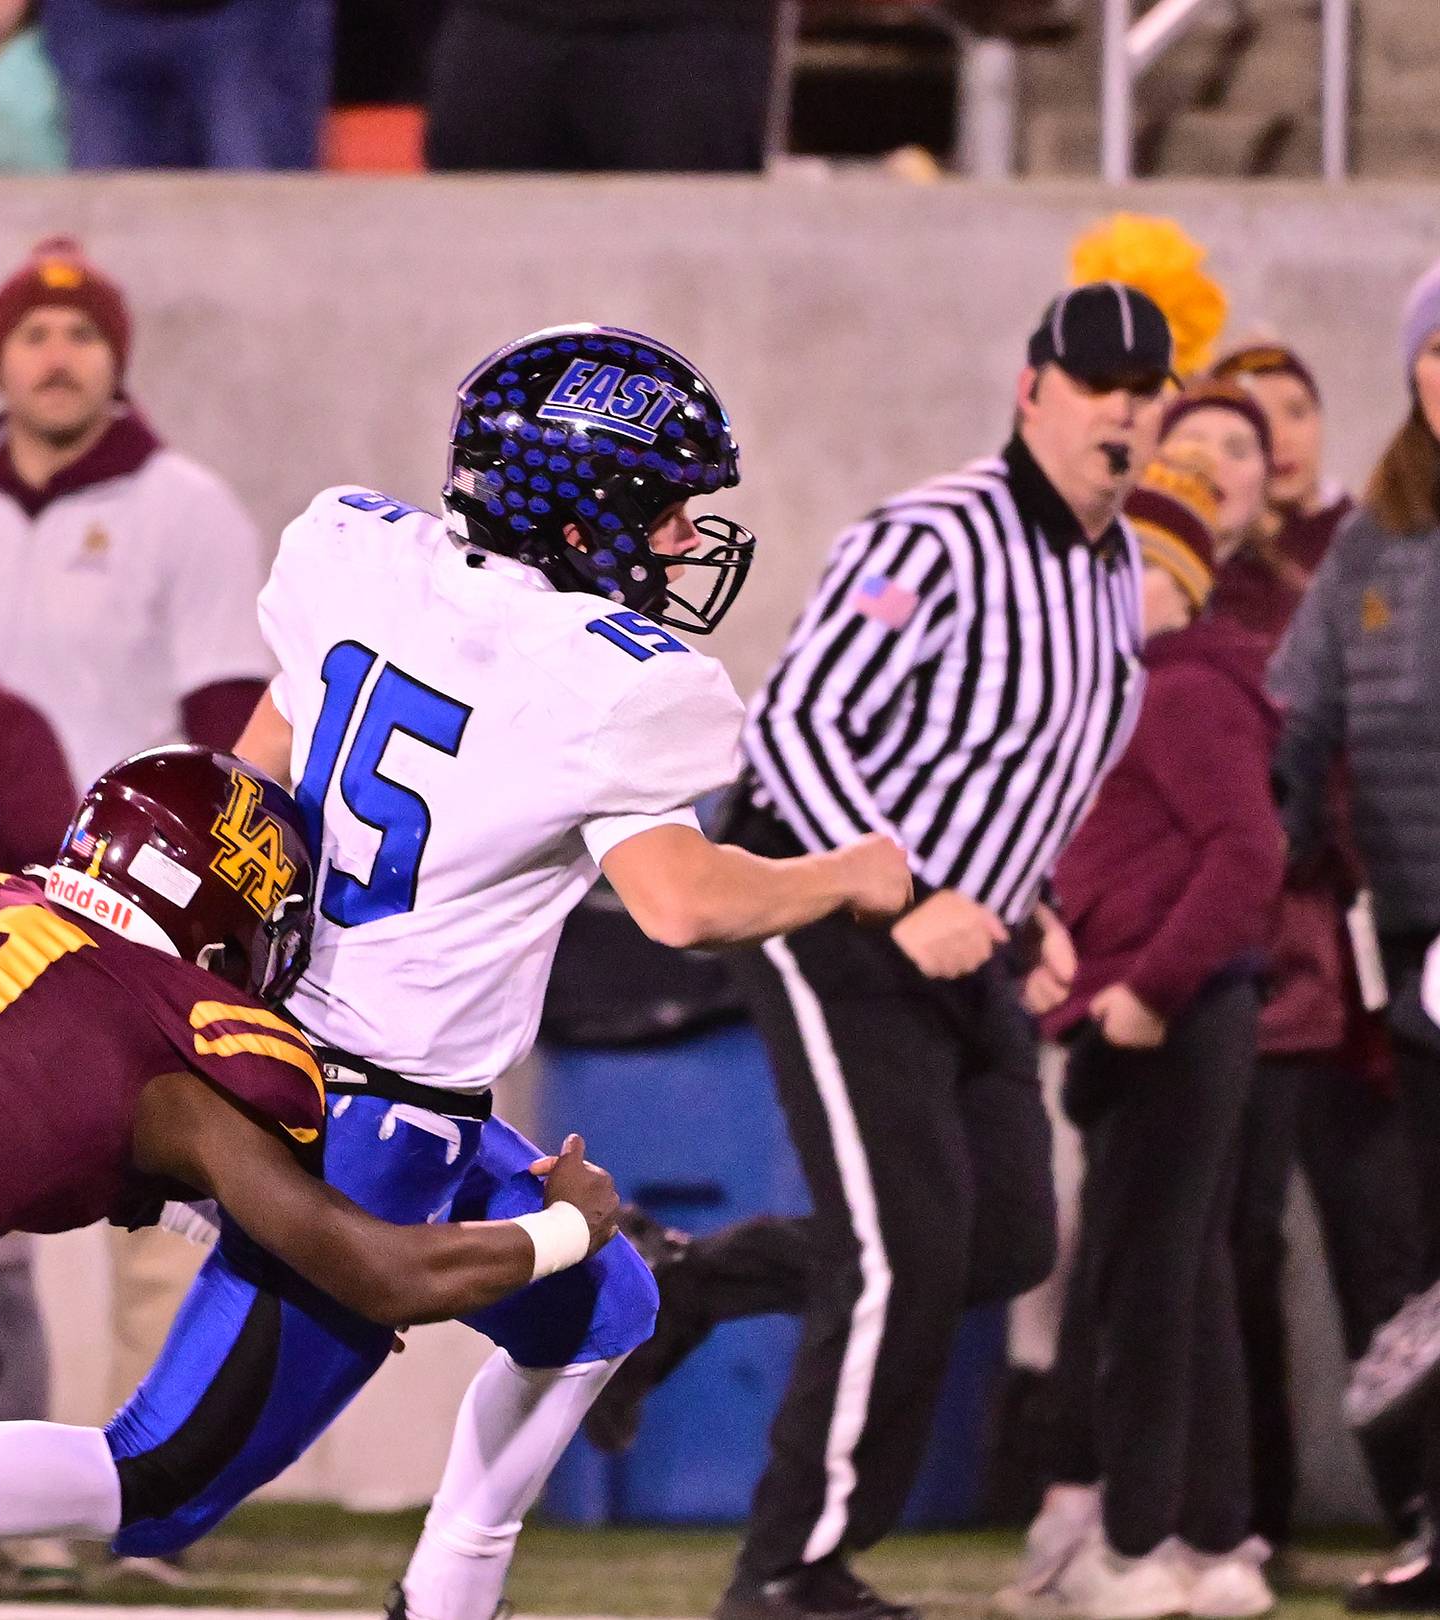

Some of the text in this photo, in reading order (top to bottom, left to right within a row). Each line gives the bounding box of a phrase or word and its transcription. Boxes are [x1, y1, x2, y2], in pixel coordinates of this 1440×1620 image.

[544, 357, 689, 431] EAST
[585, 611, 691, 663] 15
[294, 639, 474, 929] 15
[209, 767, 298, 921] LA
[47, 871, 133, 931] Riddell
